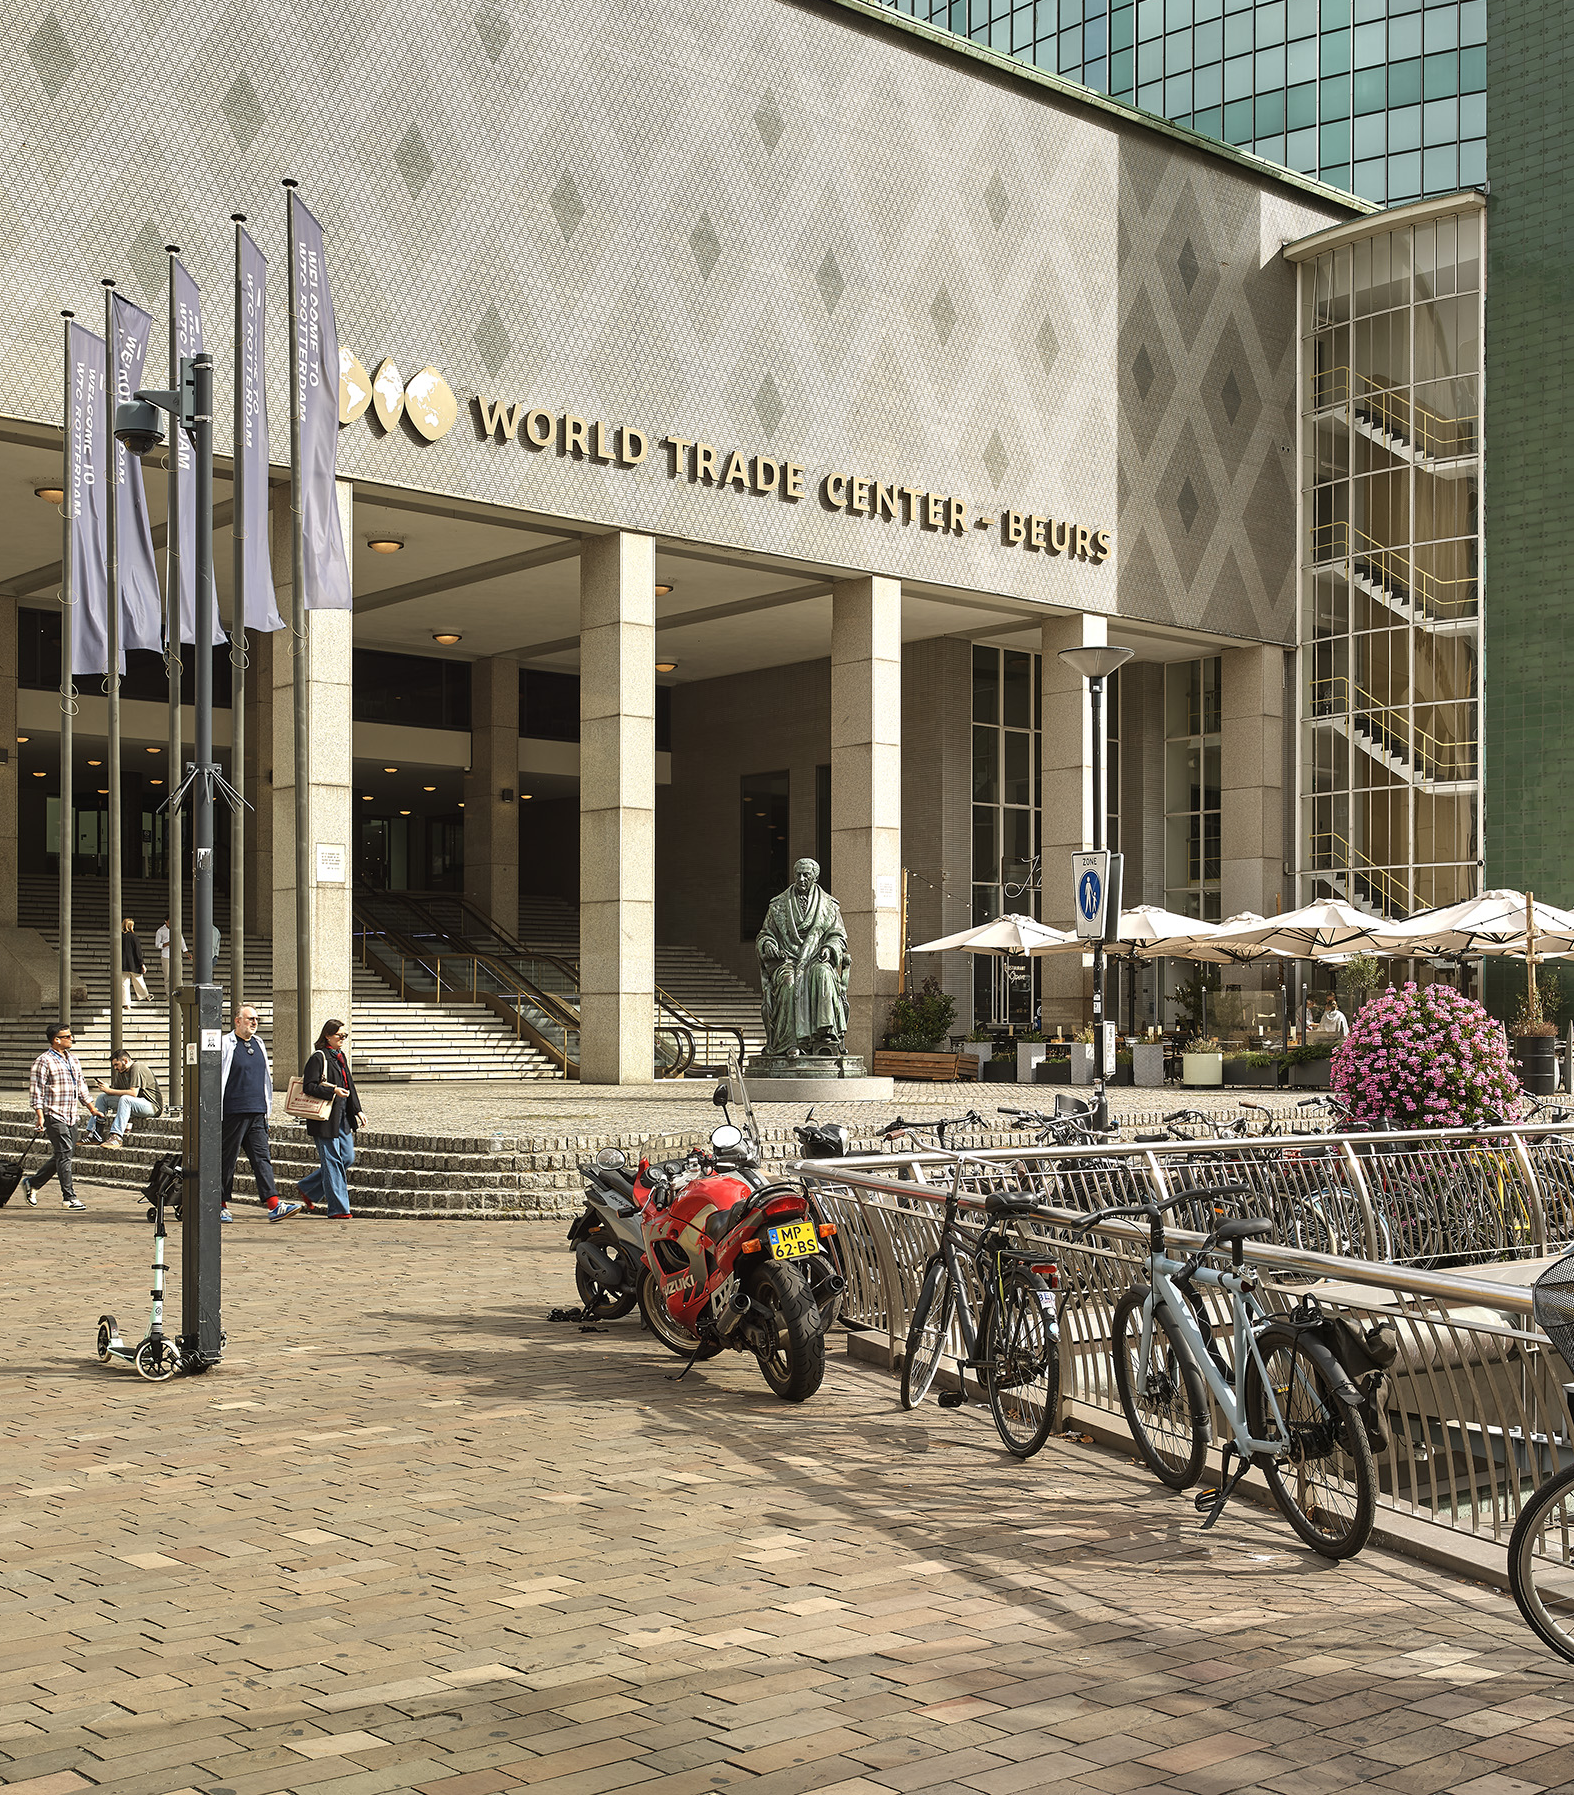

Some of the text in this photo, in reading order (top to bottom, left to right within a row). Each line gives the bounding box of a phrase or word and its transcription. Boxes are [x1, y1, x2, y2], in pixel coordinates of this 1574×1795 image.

[179, 302, 188, 344] WTC
[298, 242, 308, 423] WTC ROTTERDAM
[245, 273, 254, 448] WTC ROTTERDAM
[310, 356, 320, 388] TO
[74, 361, 86, 517] WTC ROTTERDAM
[476, 395, 649, 465] WORLD
[666, 435, 806, 499] TRADE
[825, 471, 969, 533] CENTER
[1007, 509, 1112, 561] BEURS
[1082, 857, 1098, 866] ZONE
[776, 1239, 816, 1258] 62-BS
[781, 1226, 802, 1242] MP
